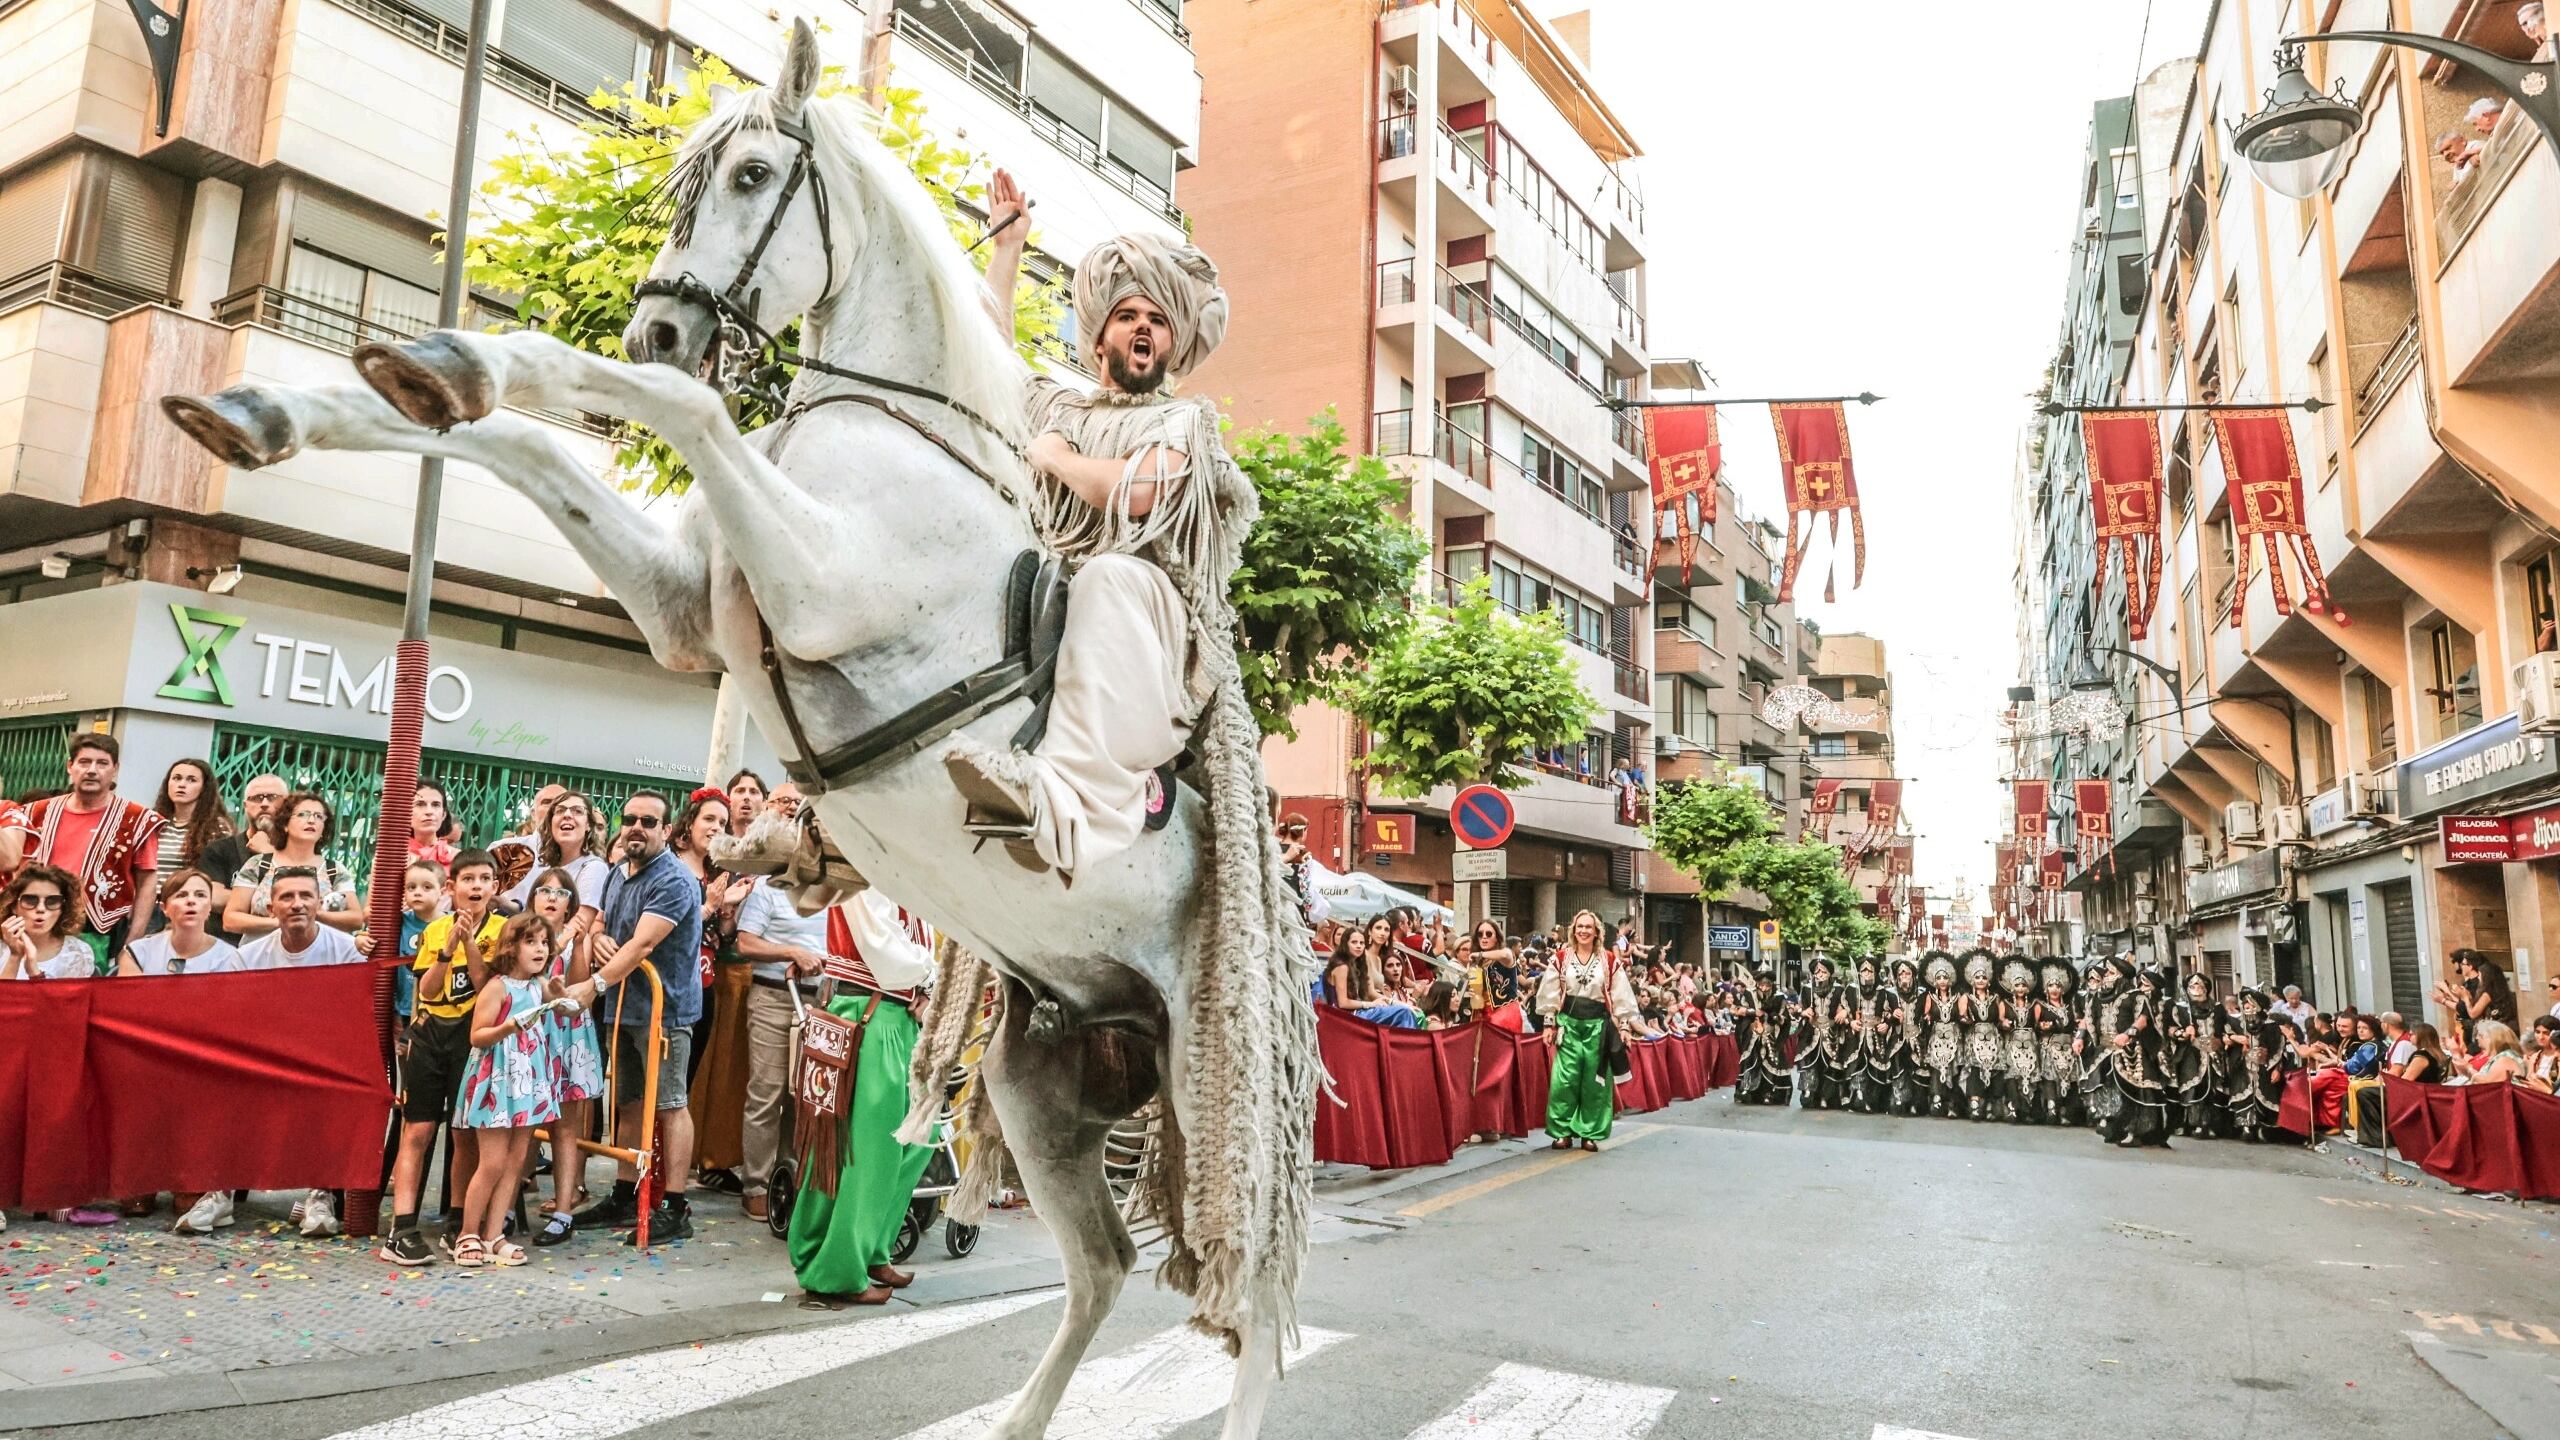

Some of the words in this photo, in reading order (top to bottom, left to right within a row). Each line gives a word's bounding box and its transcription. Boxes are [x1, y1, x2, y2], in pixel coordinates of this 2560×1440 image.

[2424, 769, 2442, 796] THE
[2442, 753, 2484, 791] ENGLISH
[2484, 737, 2526, 776] STUDIO
[2455, 819, 2499, 828] HELADERÍA
[2448, 833, 2509, 844] Jijonenca
[1371, 843, 1403, 851] TABACOS
[2451, 850, 2509, 860] HORCHATERÍA
[1709, 928, 1747, 943] SANTOS
